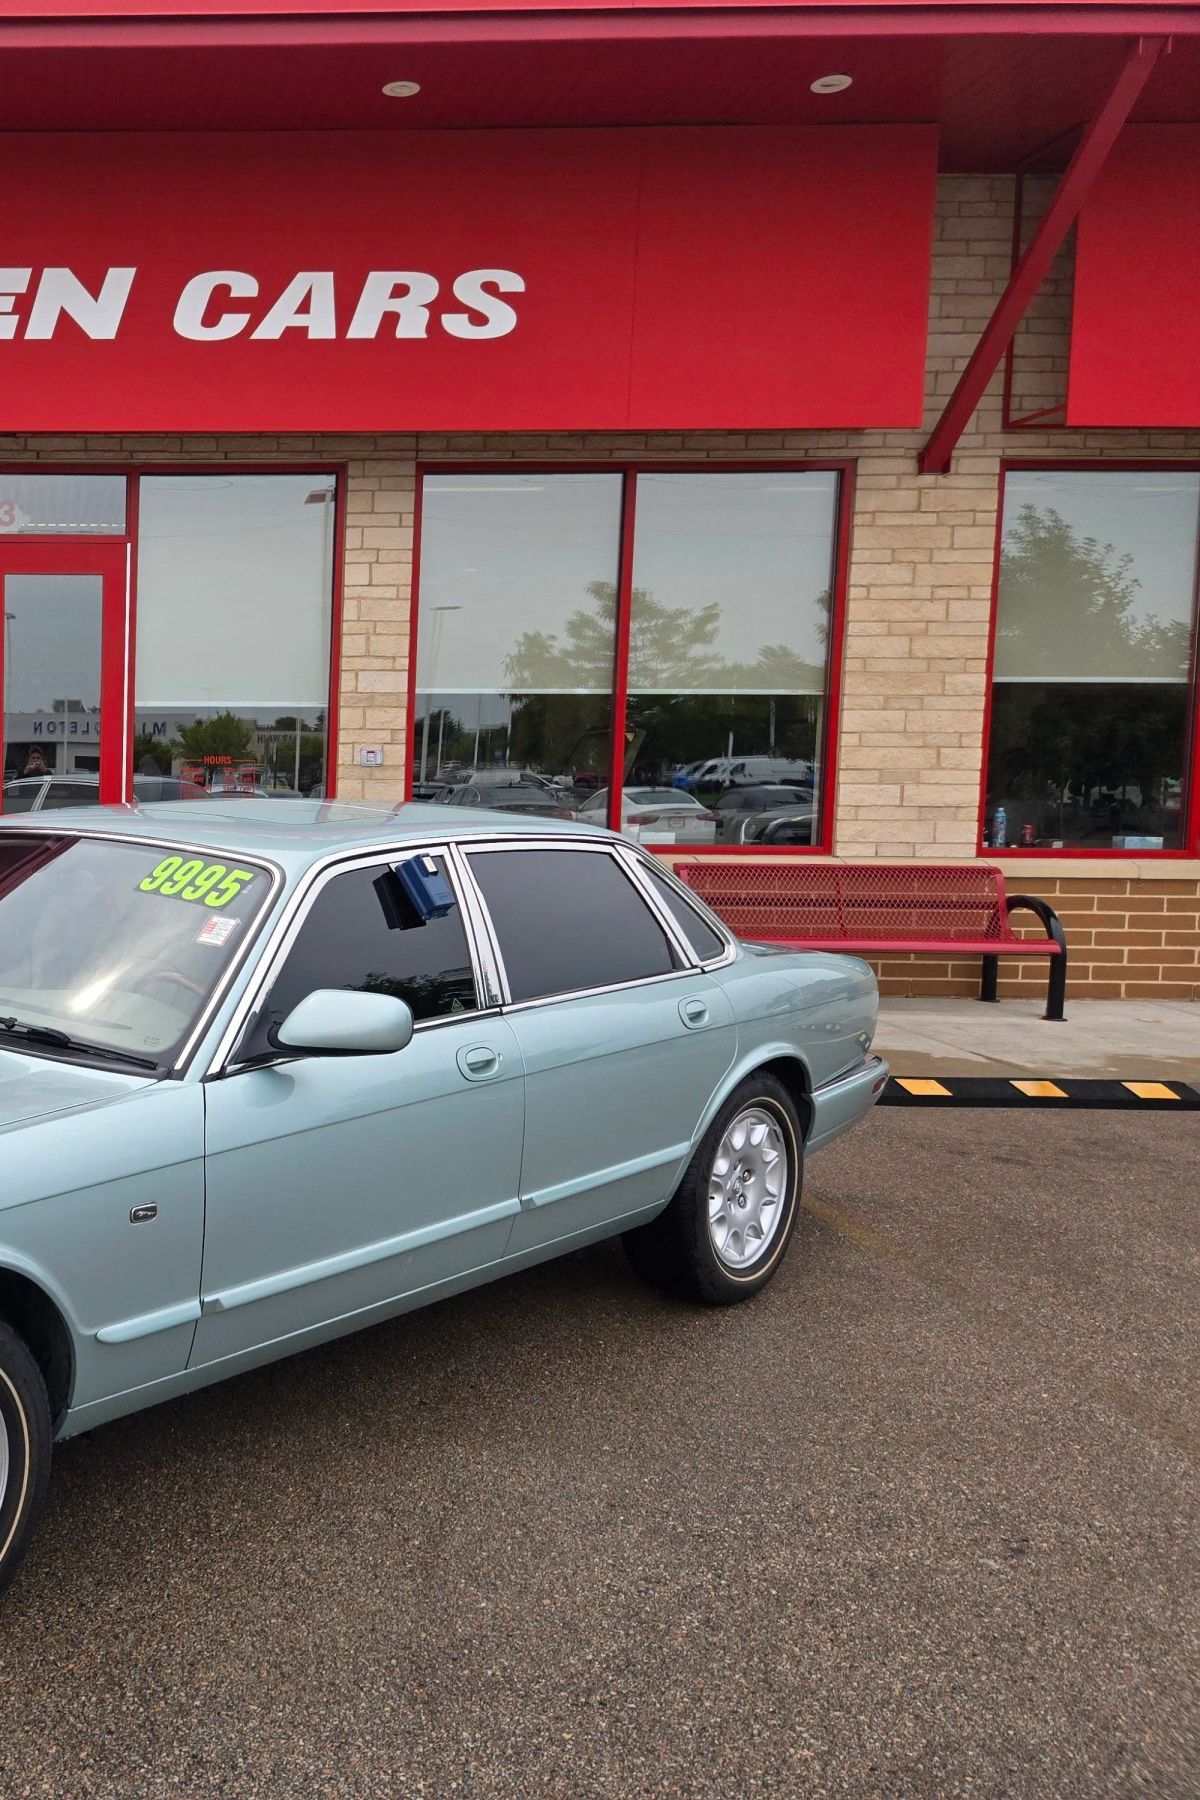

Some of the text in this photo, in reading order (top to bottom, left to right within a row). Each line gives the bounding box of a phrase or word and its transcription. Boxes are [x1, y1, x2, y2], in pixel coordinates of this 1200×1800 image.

[173, 269, 525, 341] CARS
[203, 755, 232, 765] HOURS
[139, 856, 254, 907] 9995
